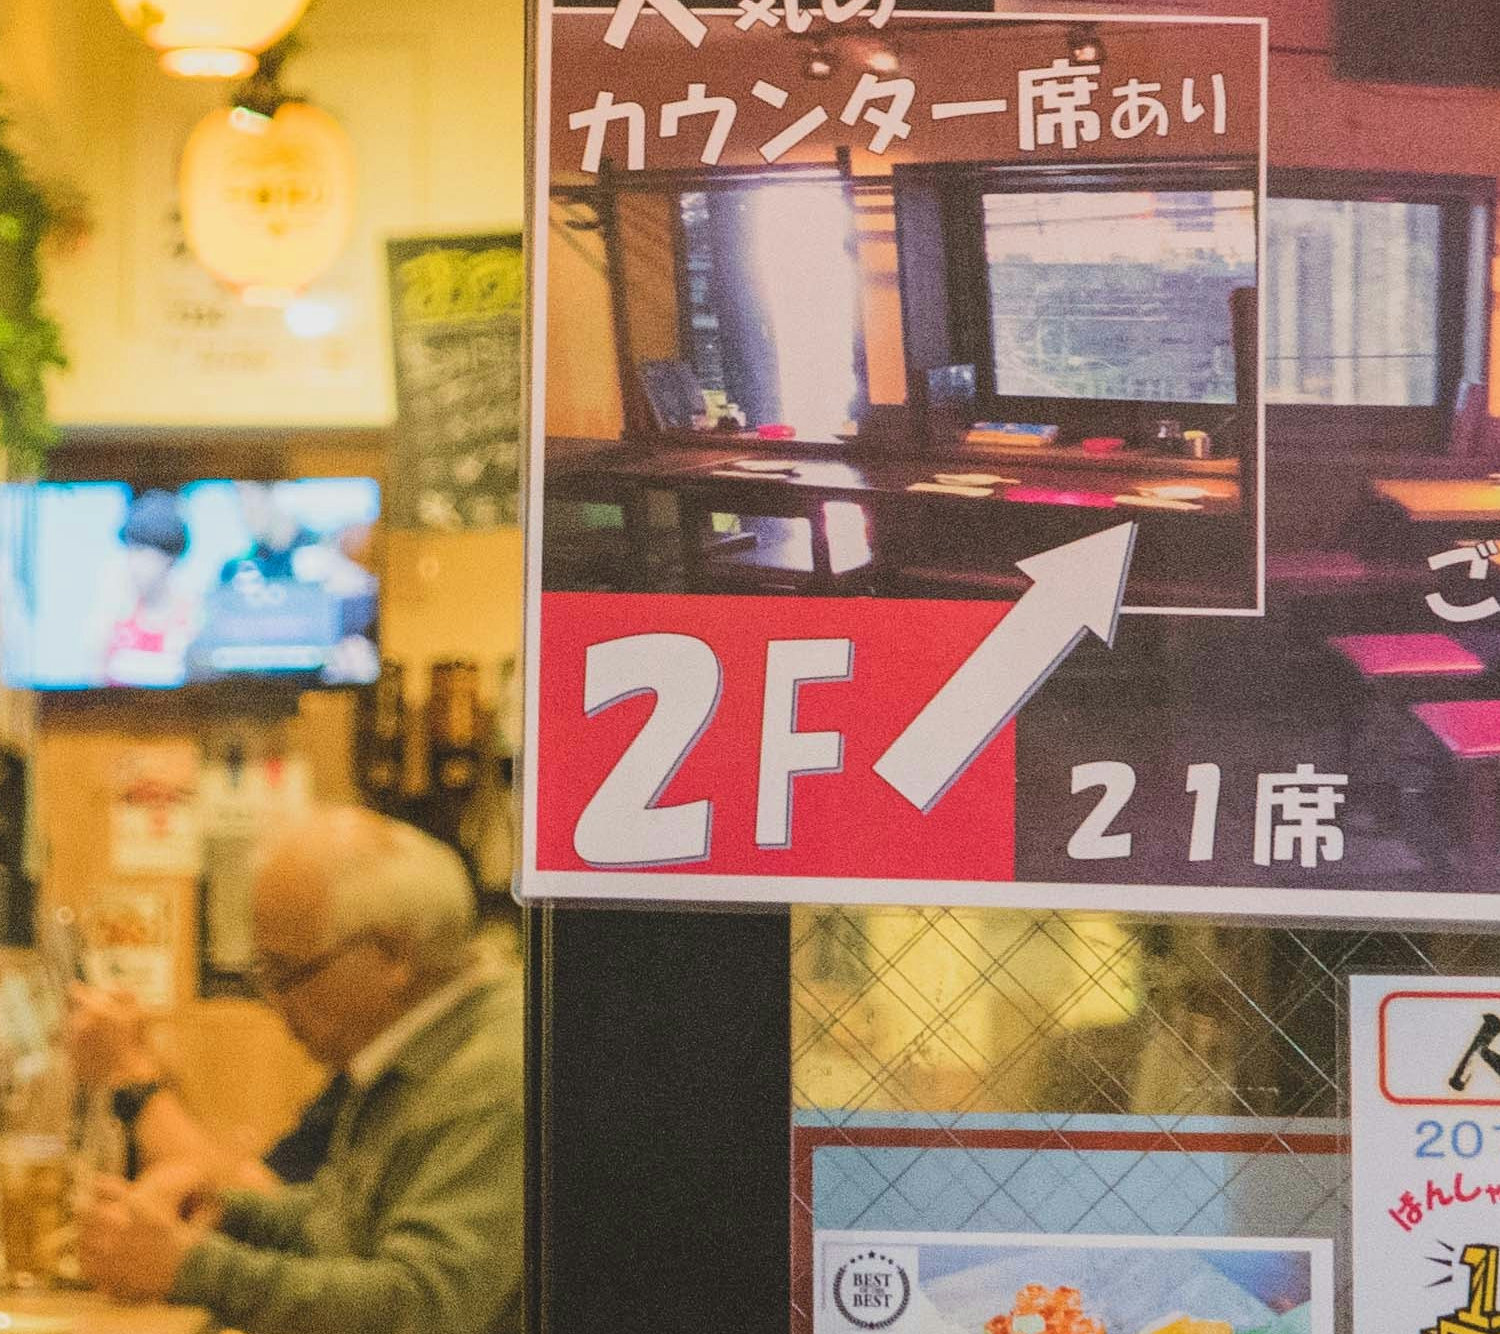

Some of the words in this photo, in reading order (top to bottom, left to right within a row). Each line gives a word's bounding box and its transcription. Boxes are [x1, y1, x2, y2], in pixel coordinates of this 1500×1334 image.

[567, 58, 1229, 174] カウンター席あり
[573, 633, 855, 867] 2F
[853, 1272, 893, 1287] BEST
[853, 1293, 894, 1308] BEST
